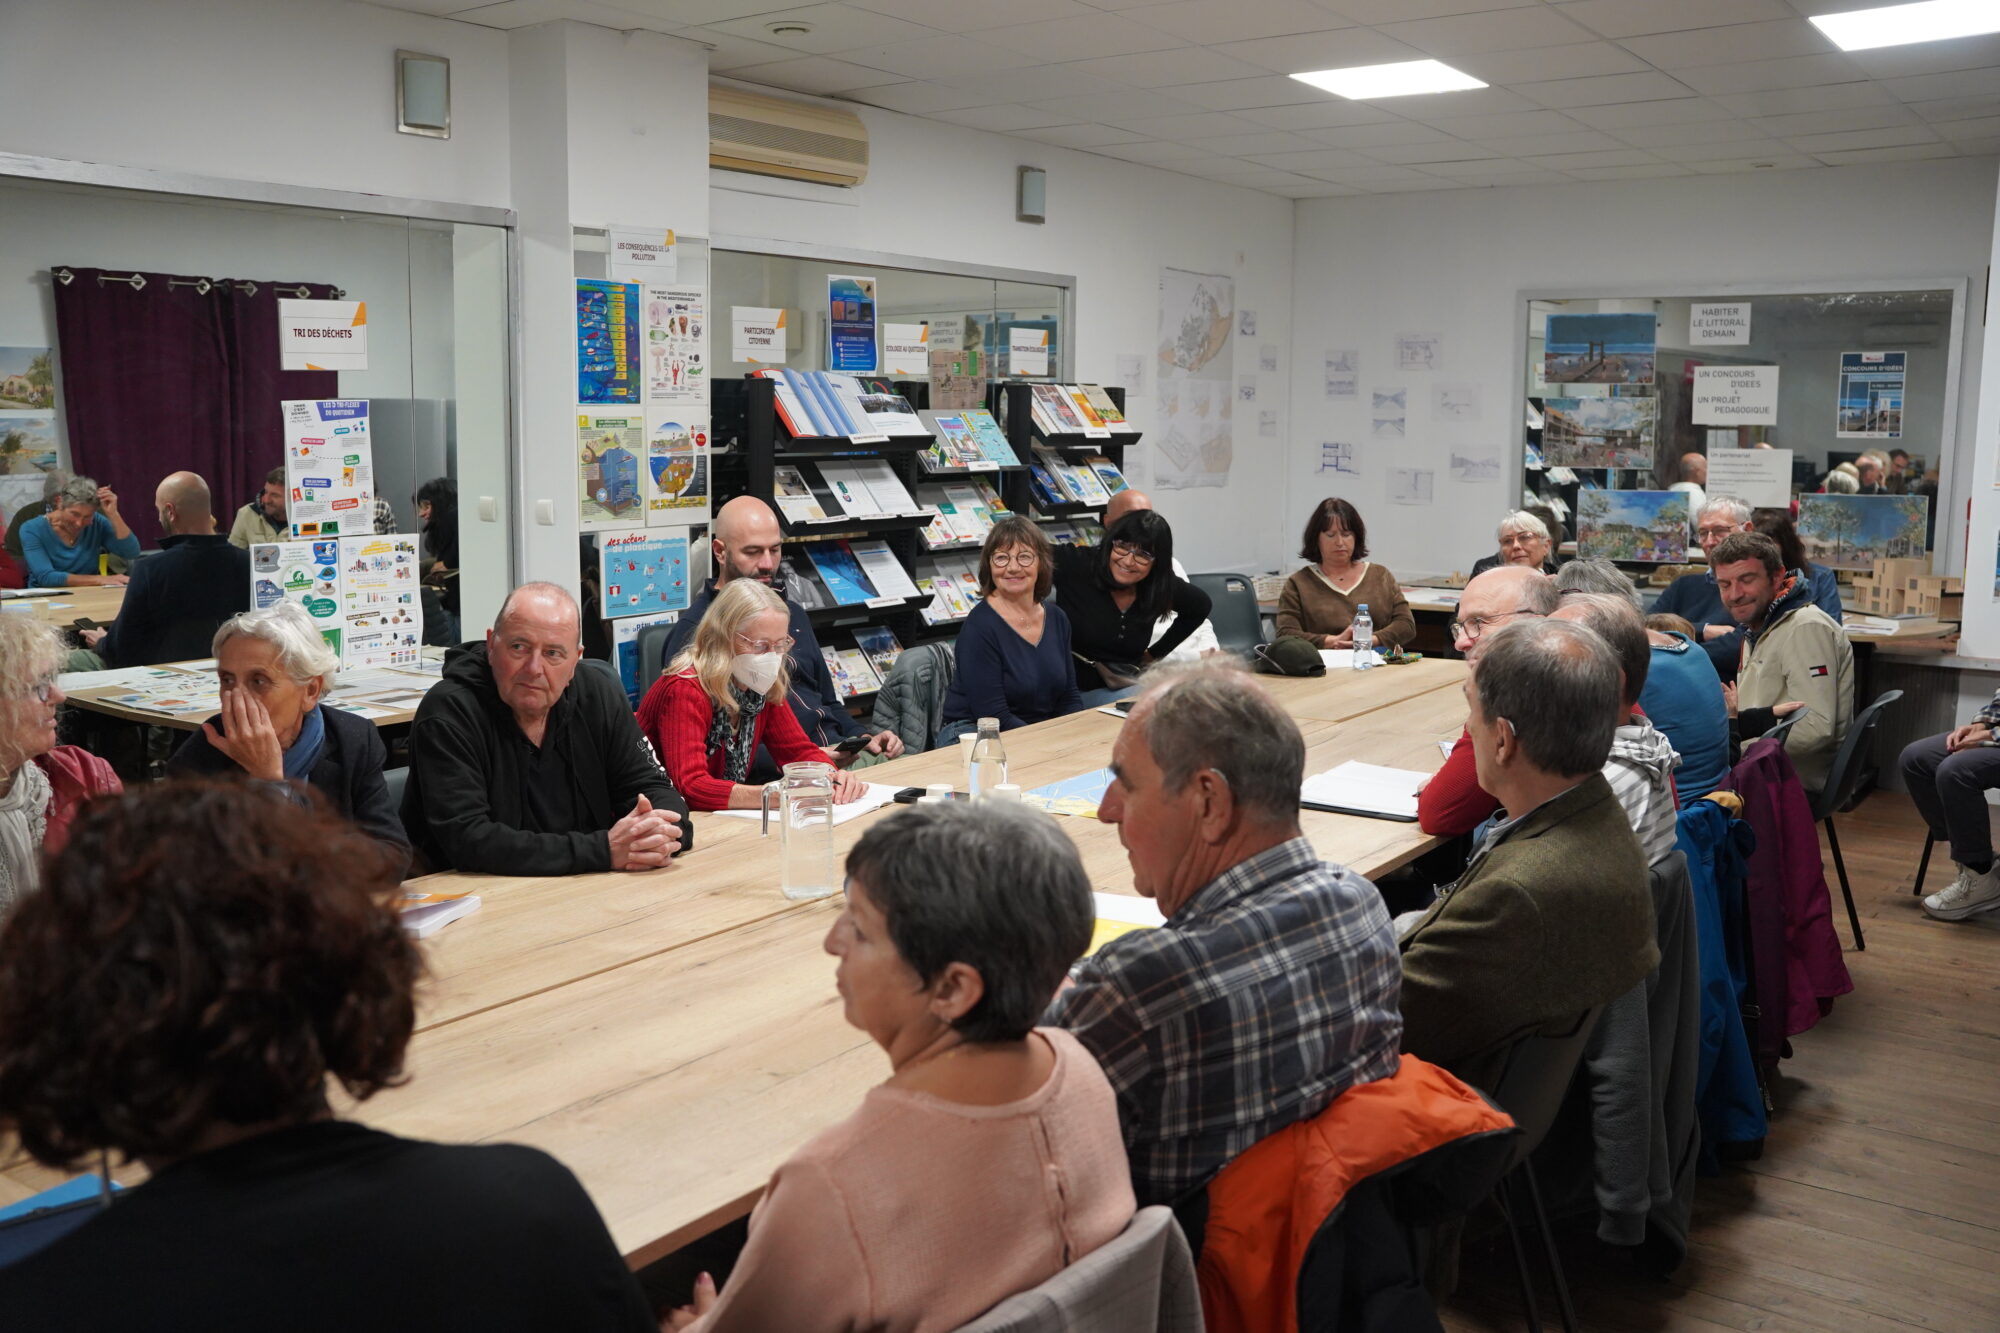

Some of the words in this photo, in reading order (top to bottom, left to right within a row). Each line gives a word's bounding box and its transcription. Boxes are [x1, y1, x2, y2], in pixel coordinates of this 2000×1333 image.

[617, 242, 625, 250] LES
[1702, 308, 1739, 316] HABITER
[1706, 318, 1747, 327] LITTORAL
[293, 328, 306, 338] TRI
[308, 328, 321, 338] DES
[322, 326, 352, 339] DÉCHETS
[744, 326, 775, 336] PARTICIPATION
[1702, 330, 1736, 338] DEMAIN
[748, 337, 771, 346] CITOYENNE
[1698, 370, 1710, 378] UN
[1712, 370, 1756, 378] CONCOURS
[1730, 380, 1761, 388] D'IDEES
[1711, 396, 1741, 404] PROJET
[1714, 406, 1770, 414] PEDAGOGIQUE
[607, 538, 620, 546] des
[622, 533, 647, 544] océans
[612, 544, 623, 552] de
[624, 542, 663, 553] plastique
